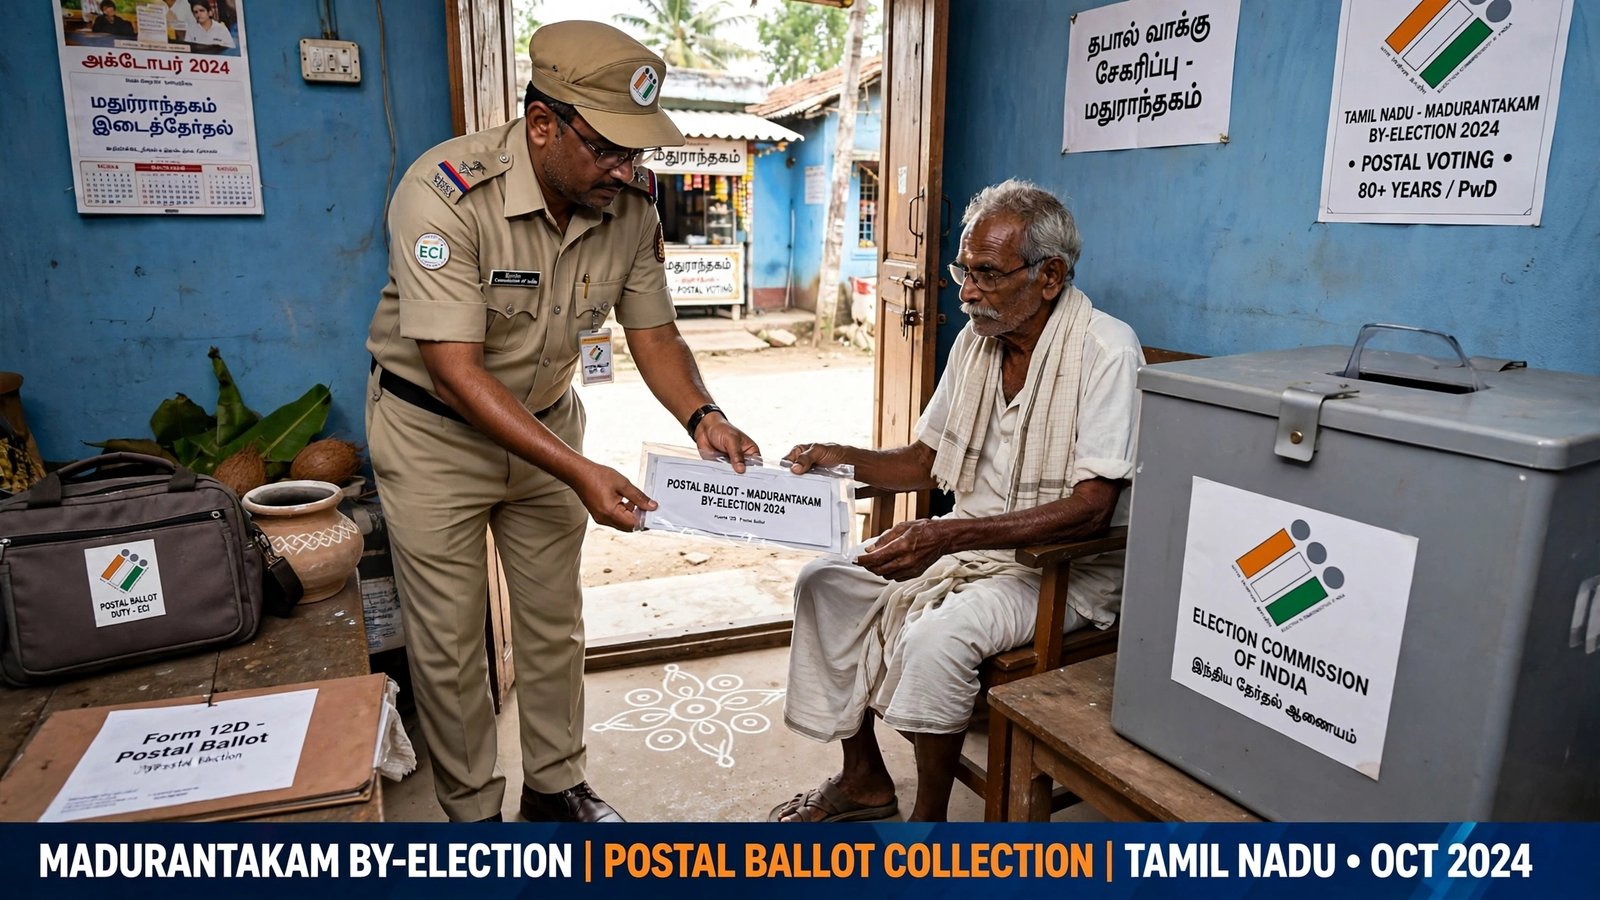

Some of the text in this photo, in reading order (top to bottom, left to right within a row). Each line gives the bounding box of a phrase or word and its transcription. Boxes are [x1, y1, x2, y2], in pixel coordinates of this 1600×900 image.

[1088, 10, 1210, 61] தபால் வாக்கு
[82, 52, 230, 75] அக்டோபர் 2024
[1096, 51, 1178, 84] சேகரிப்பு
[1085, 82, 1202, 126] மதுராந்தகம்
[1344, 108, 1377, 124] TAMIL
[1380, 106, 1414, 121] NADU
[1425, 95, 1540, 119] MADURANTAKAM
[92, 115, 233, 139] இடைத்தேர்தல்
[1369, 120, 1500, 143] BY-ELECTION 2024
[654, 148, 740, 166] மதுராந்தகம்
[1362, 154, 1421, 172] POSTAL
[1426, 150, 1494, 170] VOTING
[1358, 182, 1386, 198] 80+
[1391, 180, 1442, 198] YEARS
[1458, 180, 1497, 198] PwD
[666, 258, 731, 274] மதுராந்தகம்
[667, 479, 701, 492] POSTAL
[703, 483, 739, 496] BALLOT
[747, 488, 822, 507] MADURANTAKAM
[701, 496, 786, 515] BY-ELECTION 2024
[100, 593, 157, 611] POSTAL BALLOT
[111, 608, 130, 618] DUTY
[138, 604, 149, 613] ECI
[1193, 606, 1258, 649] ELECTION
[1261, 636, 1369, 696] COMMISSION
[1234, 649, 1308, 696] OF INDIA
[1192, 657, 1357, 744] இந்திய தேர்தல் ஆணையம்
[142, 729, 201, 744] Form
[210, 721, 250, 736] 12D
[115, 732, 269, 764] Postal Ballot
